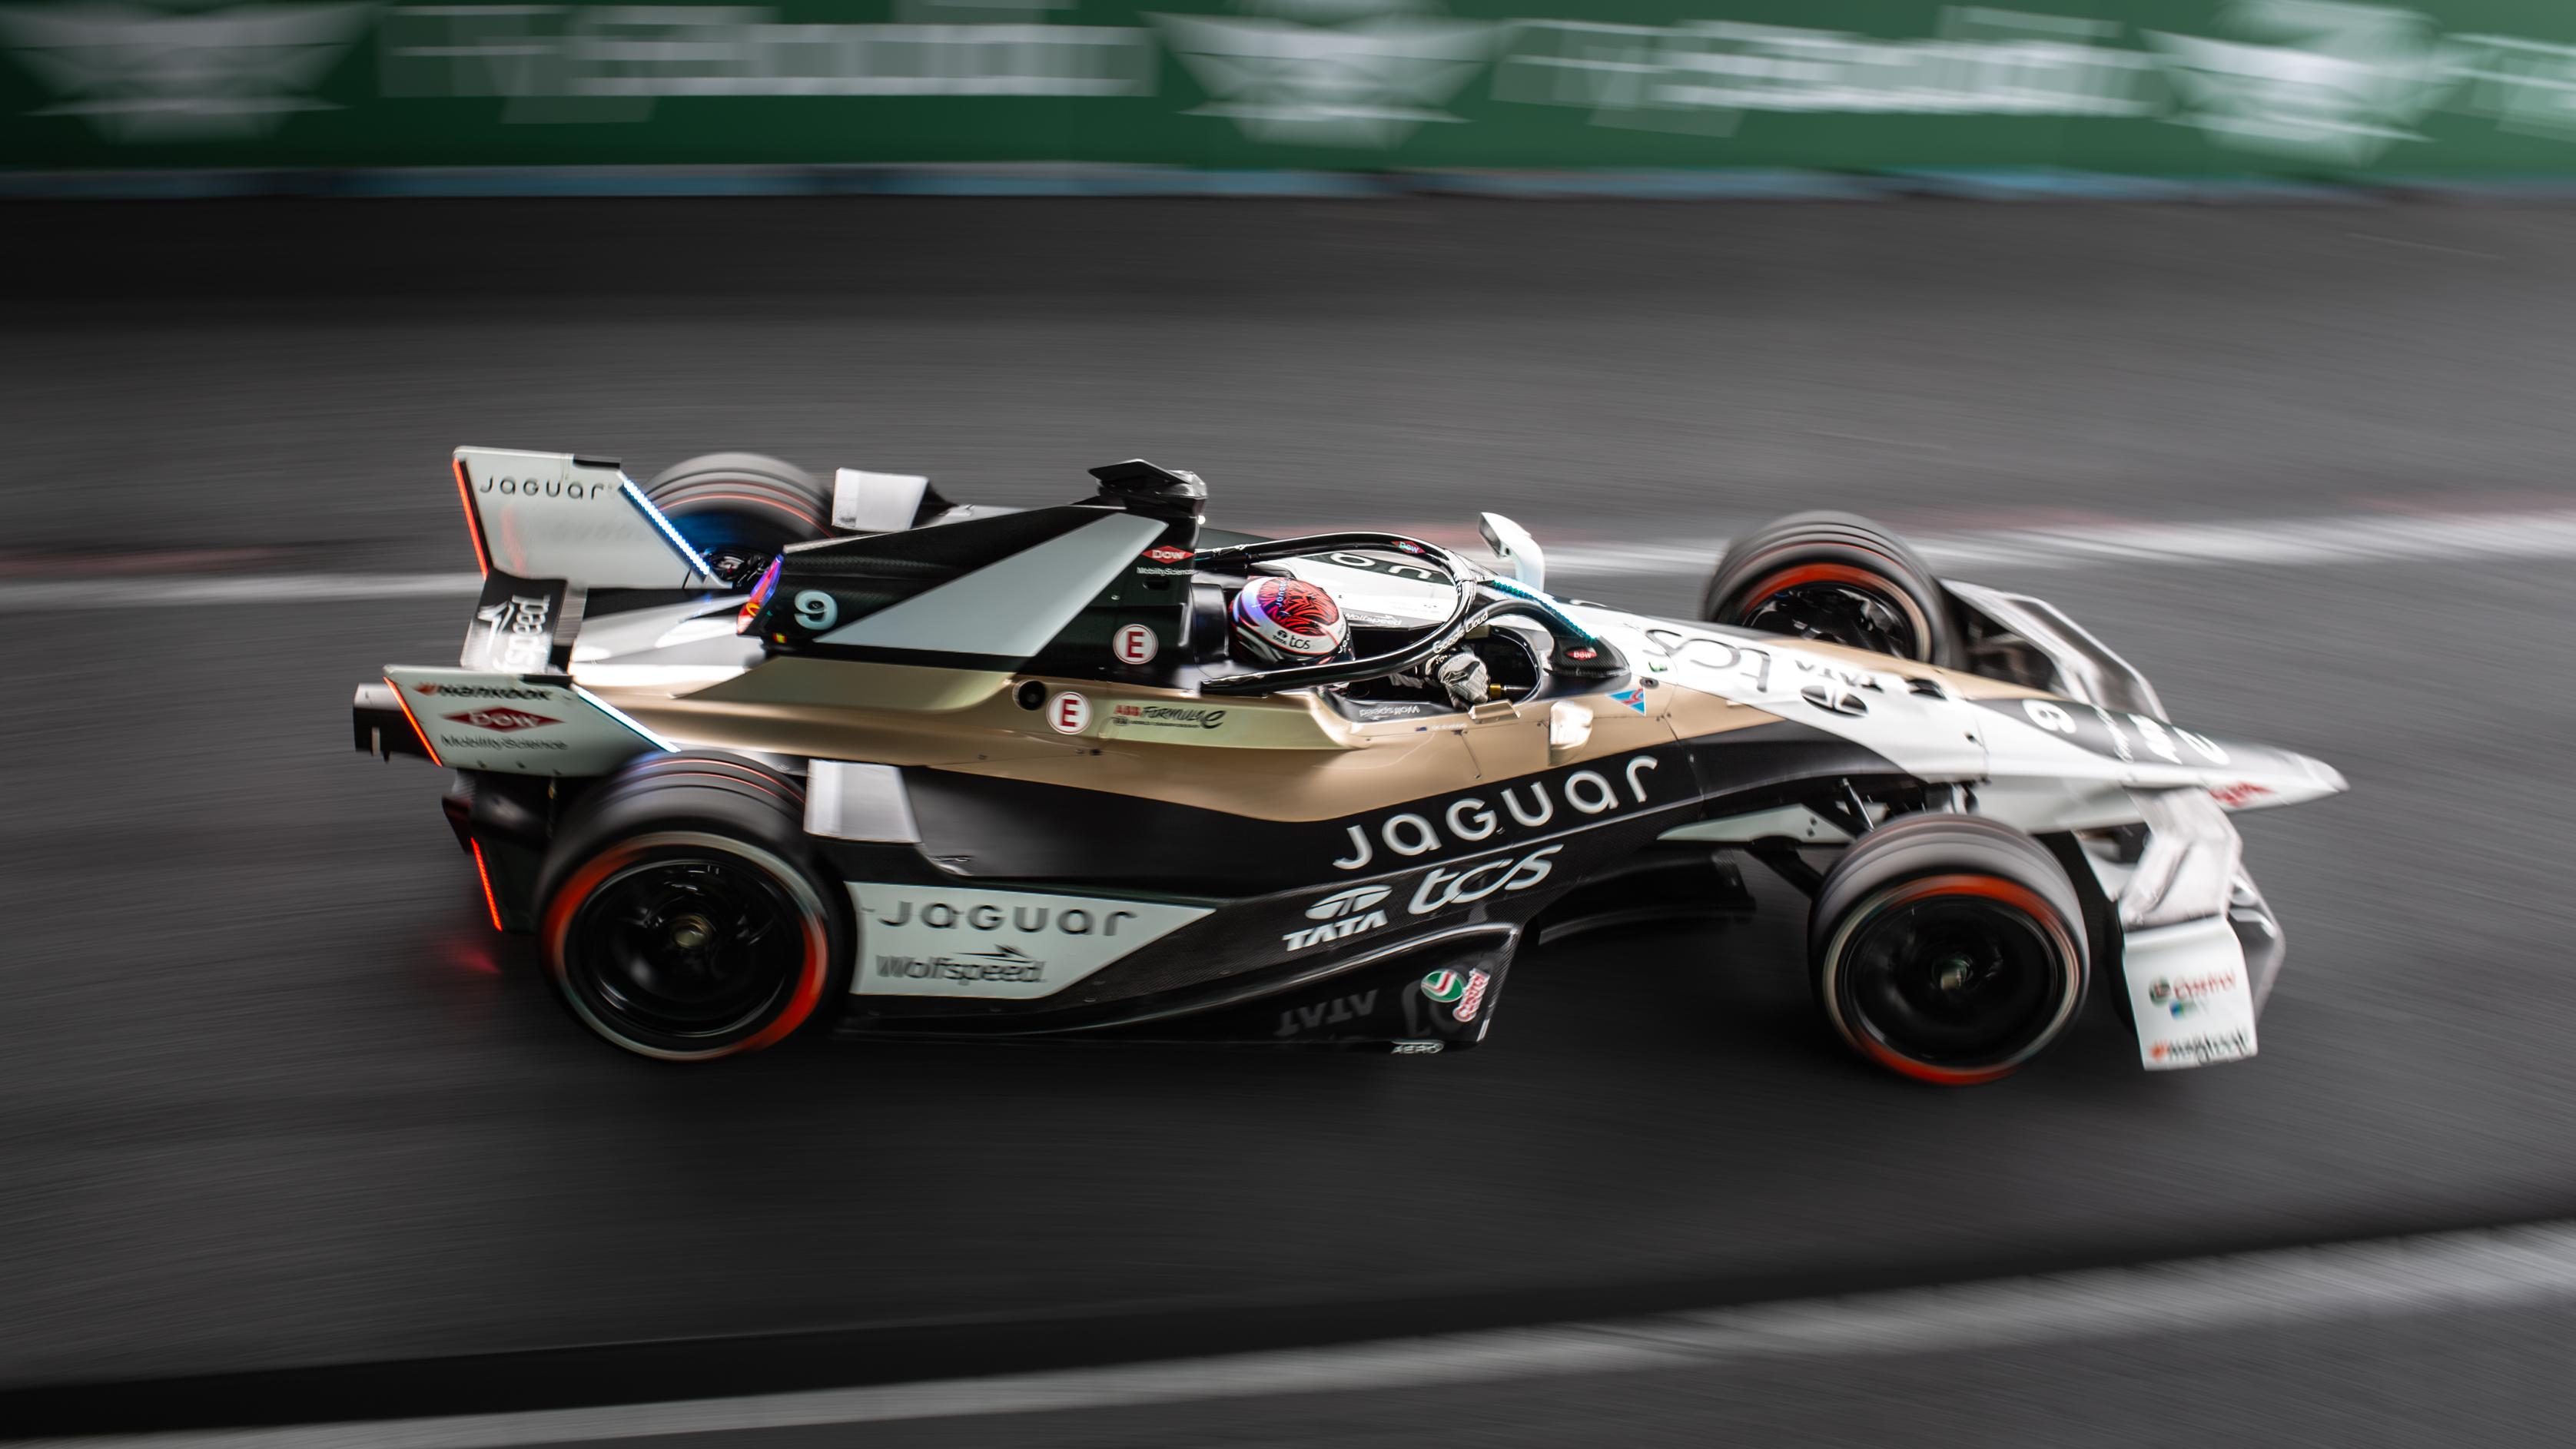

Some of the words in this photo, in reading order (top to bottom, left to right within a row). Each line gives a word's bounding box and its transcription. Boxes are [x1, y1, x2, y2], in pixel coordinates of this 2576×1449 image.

[1152, 549, 1186, 559] DOW
[794, 589, 838, 630] 9
[1465, 609, 1489, 633] Cloud
[1126, 631, 1146, 658] E
[1060, 698, 1081, 728] E
[1282, 910, 1389, 952] TATA
